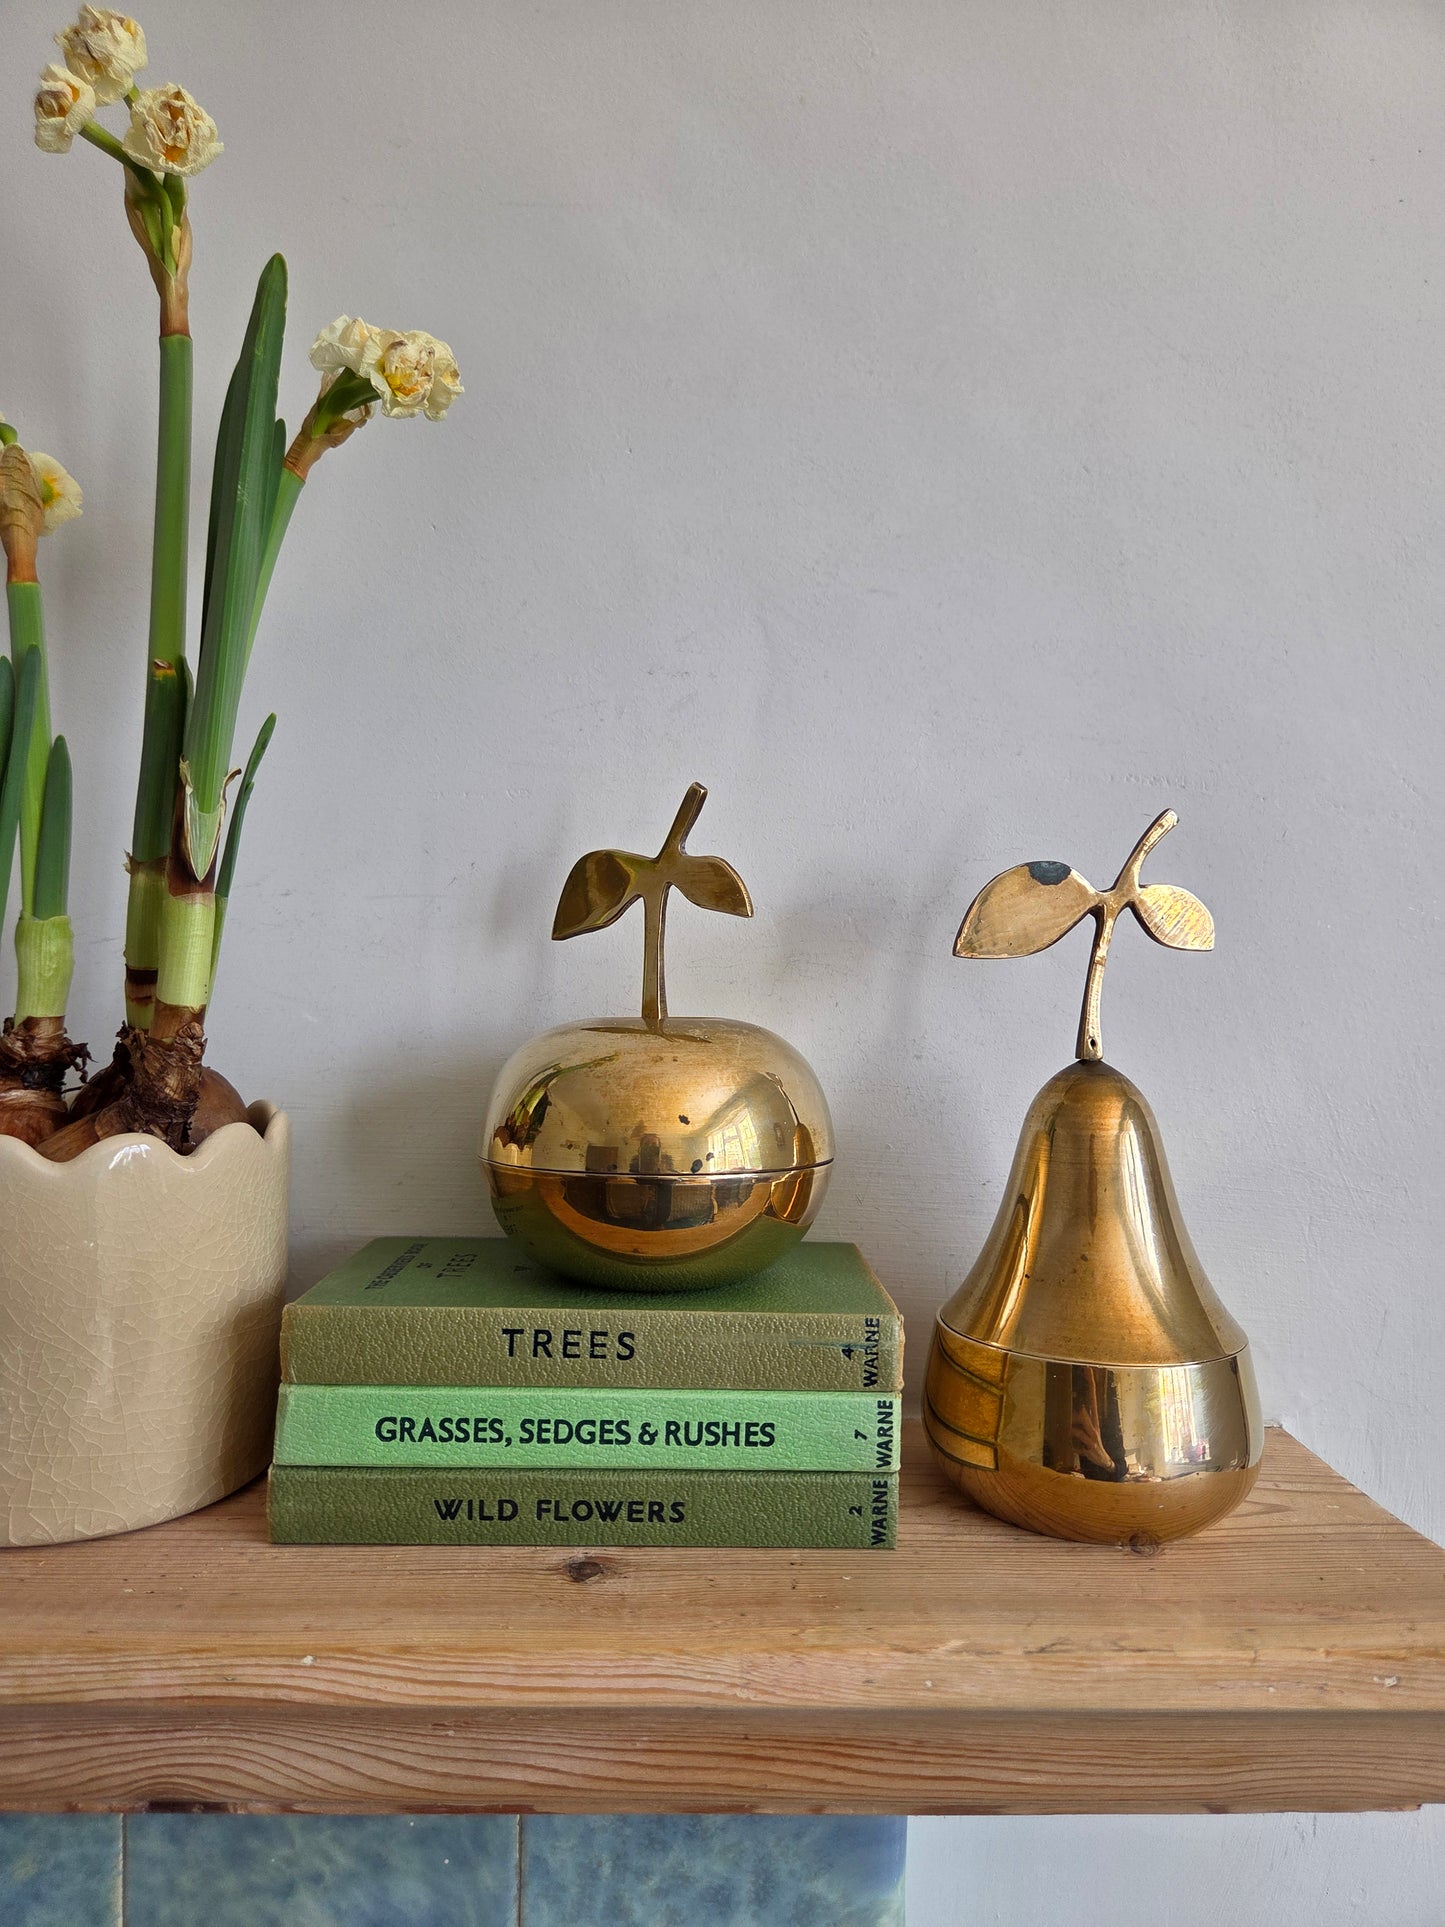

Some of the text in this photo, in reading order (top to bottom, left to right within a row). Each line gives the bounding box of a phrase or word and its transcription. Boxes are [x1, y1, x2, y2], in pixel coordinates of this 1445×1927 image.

[436, 1254, 479, 1278] TREES
[501, 1328, 636, 1361] TREES
[841, 1345, 855, 1361] 4
[862, 1317, 880, 1388] WARNE
[374, 1416, 776, 1448] GRASSES, SEDGES & RUSHES
[854, 1428, 868, 1441] 7
[875, 1400, 894, 1469] WARNE
[433, 1499, 686, 1524] WILD FLOWERS
[848, 1505, 863, 1517] 2
[870, 1480, 889, 1546] WARNE
